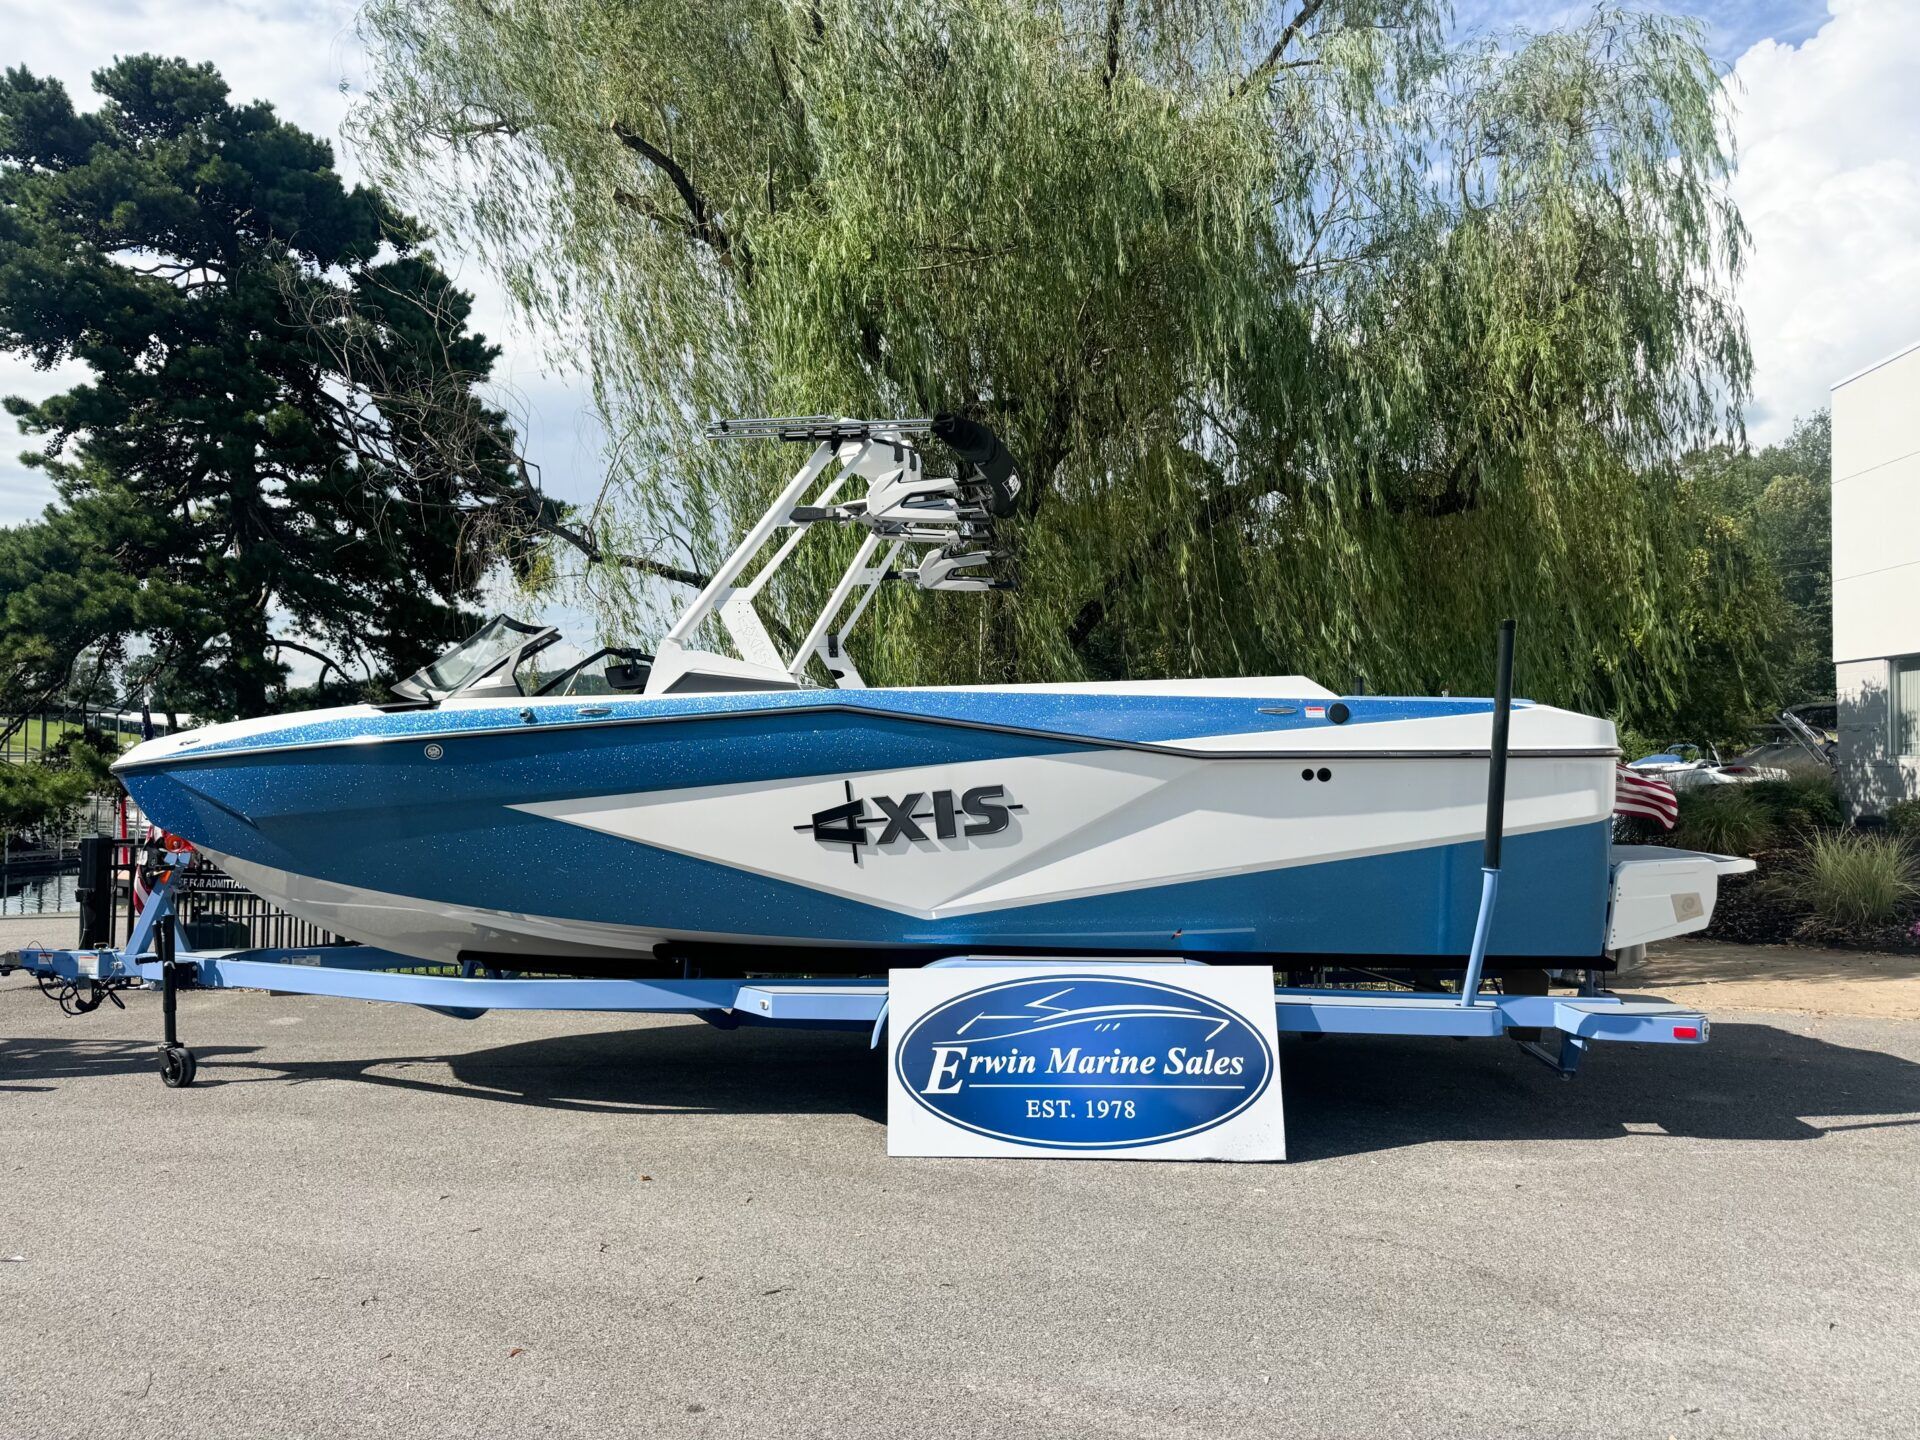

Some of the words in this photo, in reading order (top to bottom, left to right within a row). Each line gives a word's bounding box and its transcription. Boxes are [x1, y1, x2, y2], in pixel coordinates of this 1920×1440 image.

[811, 784, 1010, 846] AXIS
[920, 1046, 1036, 1094] Erwin
[1044, 1047, 1156, 1075] Marine
[1164, 1047, 1244, 1075] Sales
[1025, 1099, 1076, 1119] EST.
[1086, 1100, 1136, 1119] 1978
